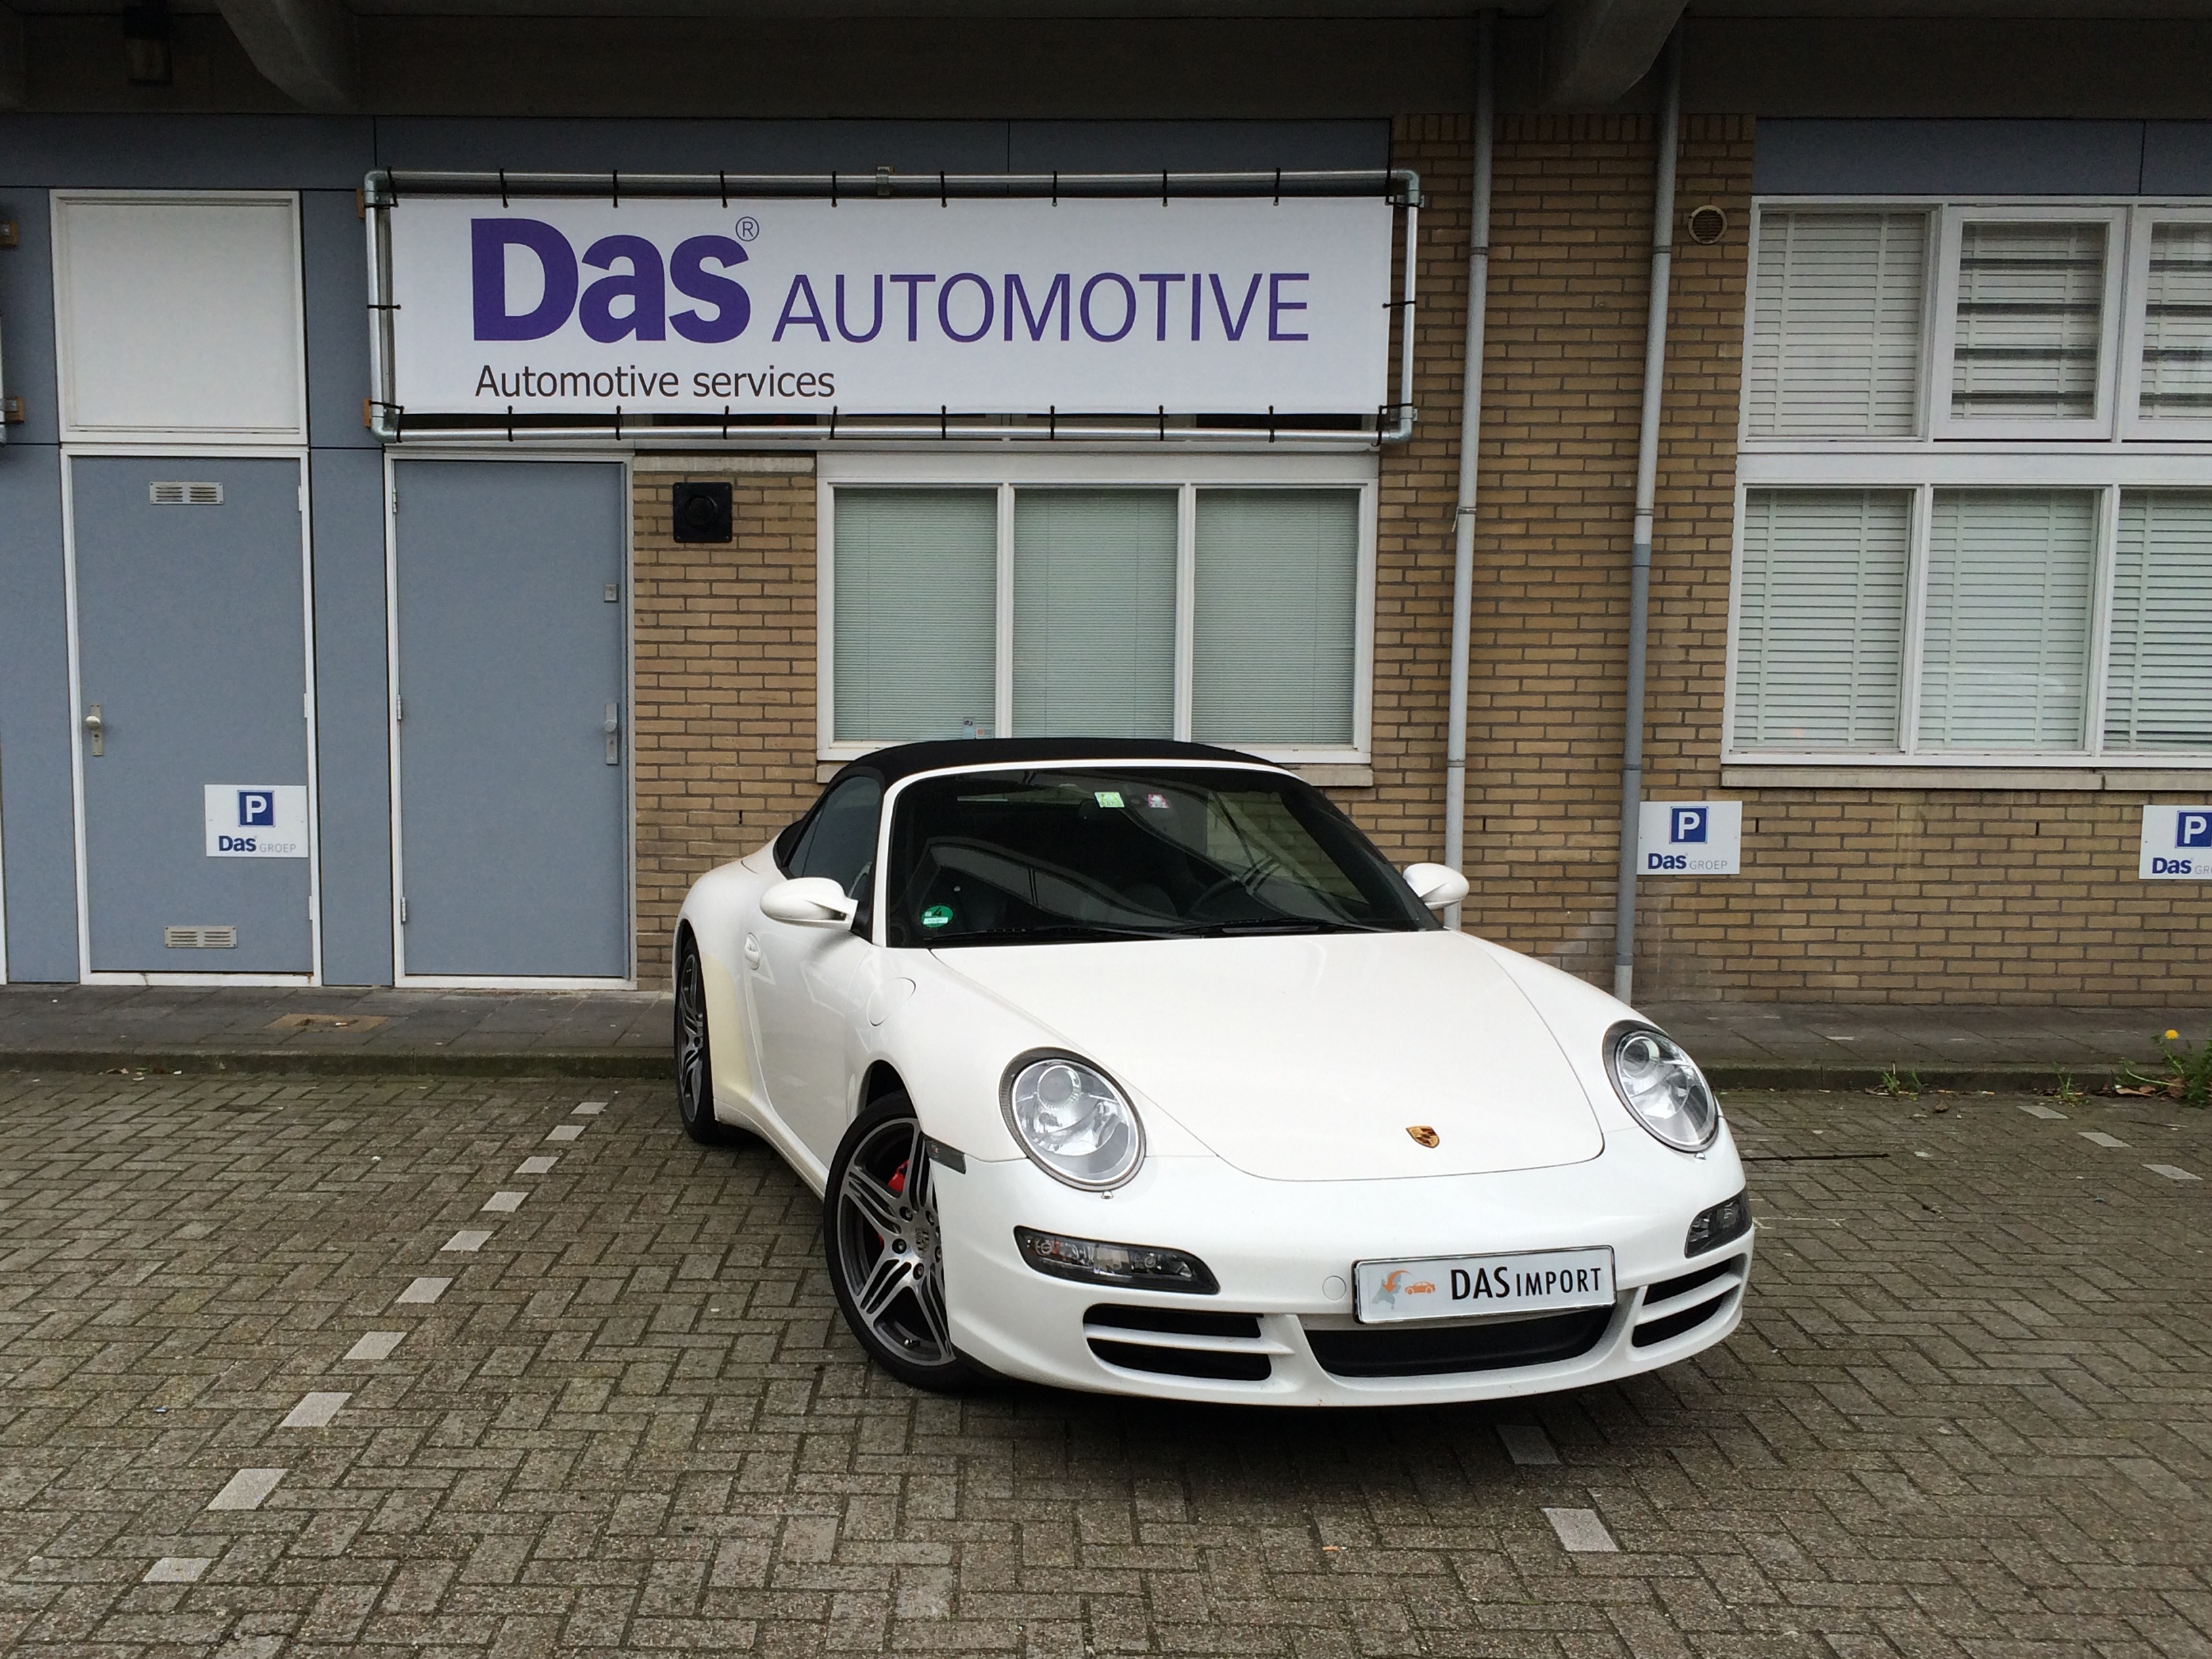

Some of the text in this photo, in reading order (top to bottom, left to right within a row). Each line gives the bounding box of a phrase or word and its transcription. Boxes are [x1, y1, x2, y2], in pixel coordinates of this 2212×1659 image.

[771, 272, 1310, 342] AUTOMOTIVE
[475, 365, 836, 398] Automotive services
[246, 795, 267, 823] P
[1677, 811, 1700, 840] P
[2184, 815, 2207, 844] P
[218, 835, 297, 853] Das GROEP
[1647, 853, 1727, 869] Das GROEP
[2152, 857, 2212, 875] Das GR
[933, 907, 942, 917] 4
[1450, 1266, 1601, 1300] DAS IMPORT
